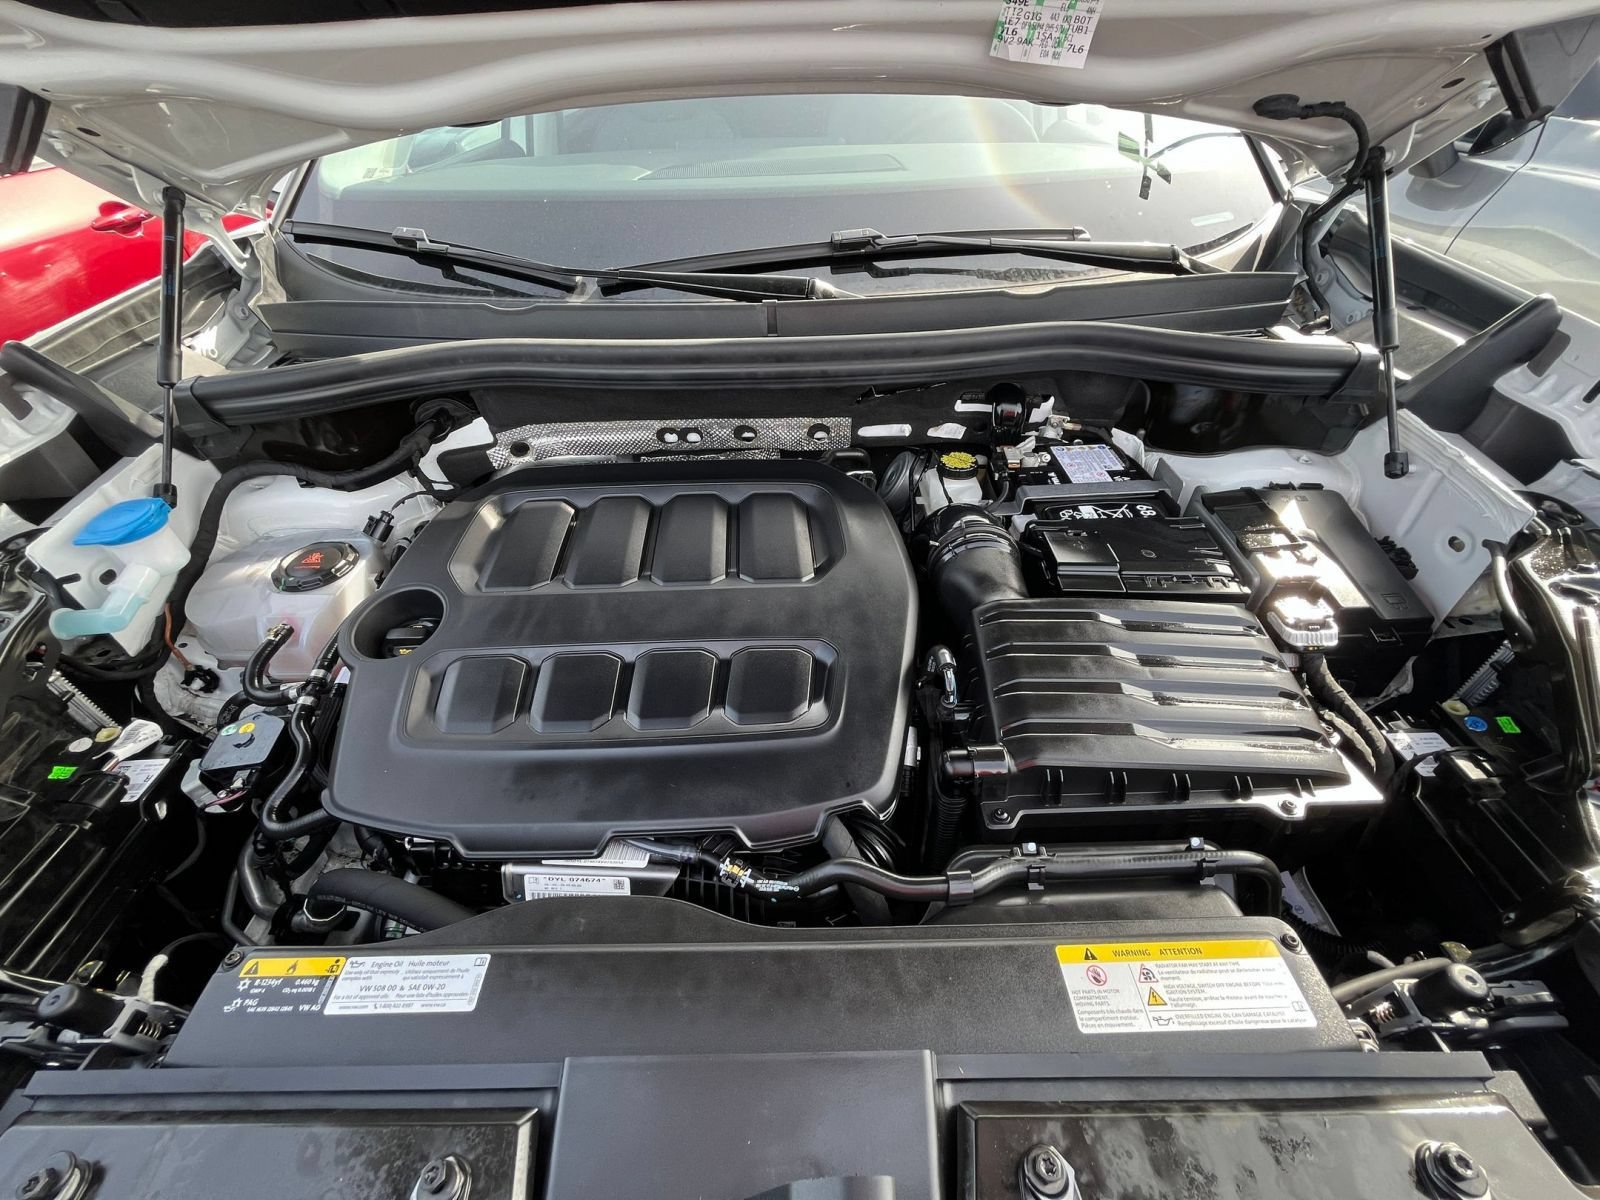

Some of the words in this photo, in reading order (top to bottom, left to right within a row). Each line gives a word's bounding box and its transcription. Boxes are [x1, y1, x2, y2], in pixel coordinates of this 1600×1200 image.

[1066, 43, 1084, 54] 7L6
[1111, 948, 1151, 957] WARNING
[1159, 947, 1203, 956] ATTENTION
[370, 960, 396, 970] Engine
[254, 978, 283, 987] R-1234yf
[372, 984, 386, 992] 508
[386, 984, 398, 992] 00
[243, 998, 260, 1007] PAG
[299, 1004, 310, 1012] VW
